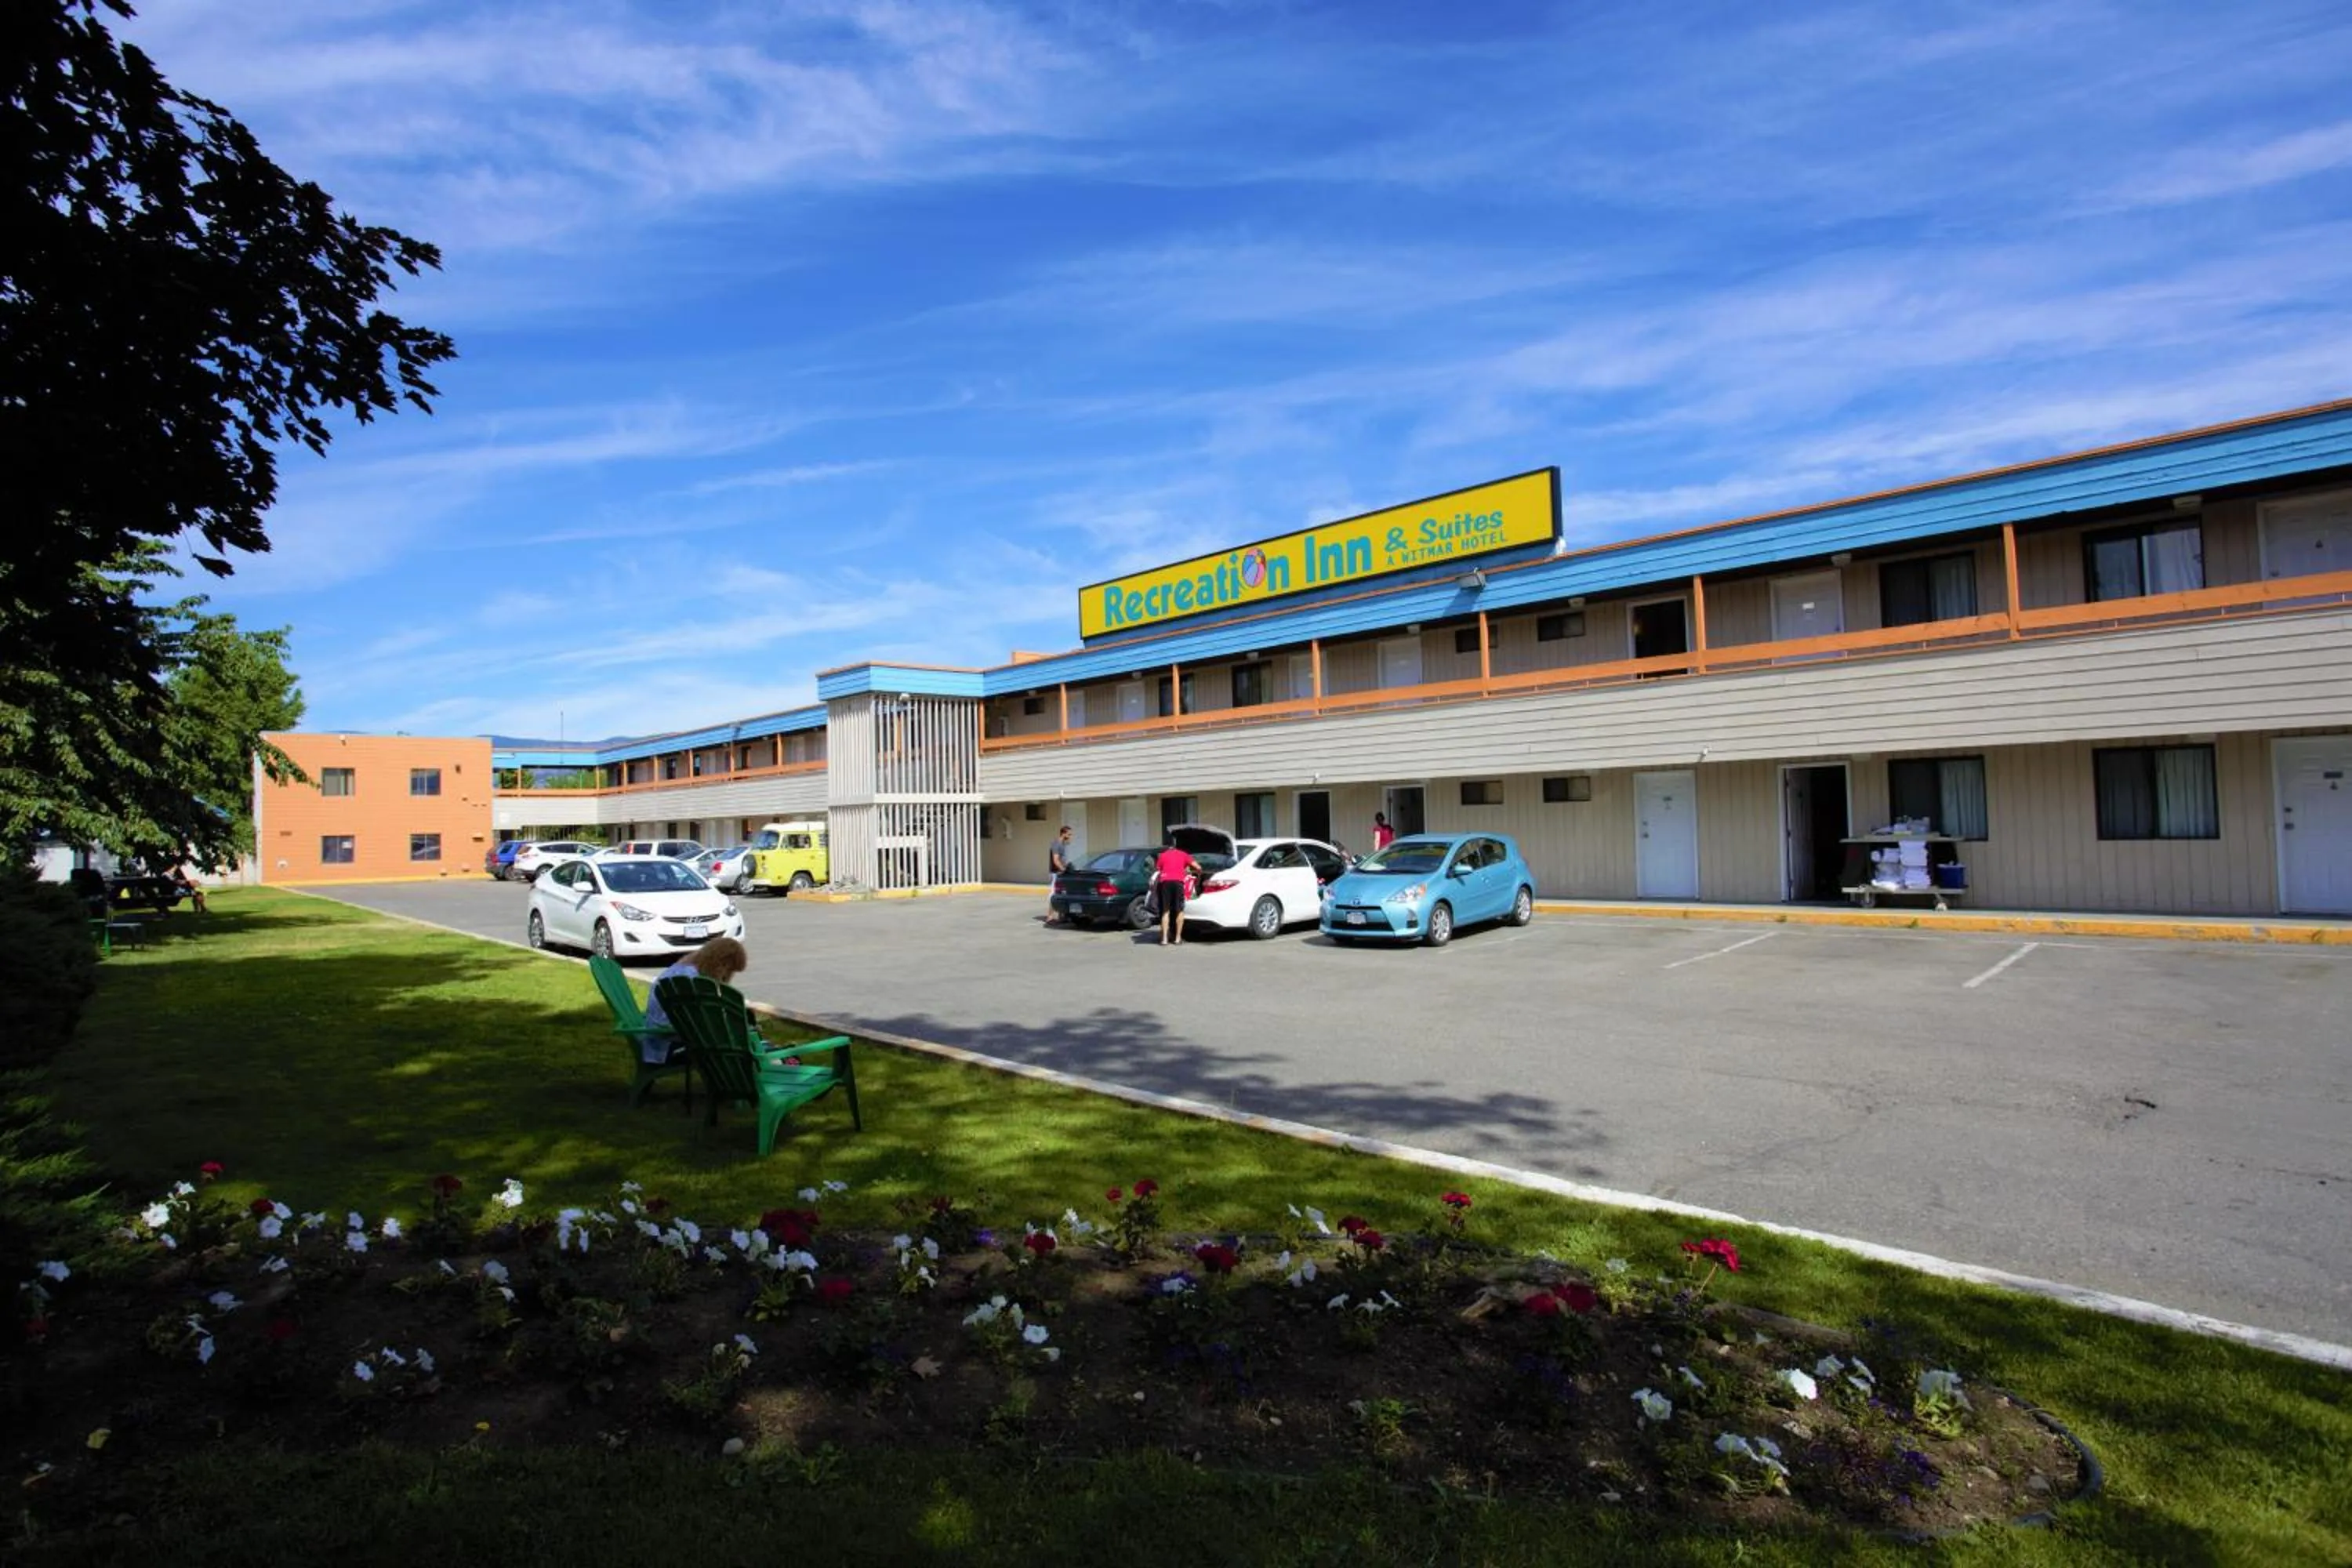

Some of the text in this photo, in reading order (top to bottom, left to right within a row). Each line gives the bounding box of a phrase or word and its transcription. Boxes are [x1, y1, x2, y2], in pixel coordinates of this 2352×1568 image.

[1104, 510, 1504, 627] Recreation Inn & Suites
[1387, 553, 1395, 565] A
[1461, 531, 1507, 550] HOTEL
